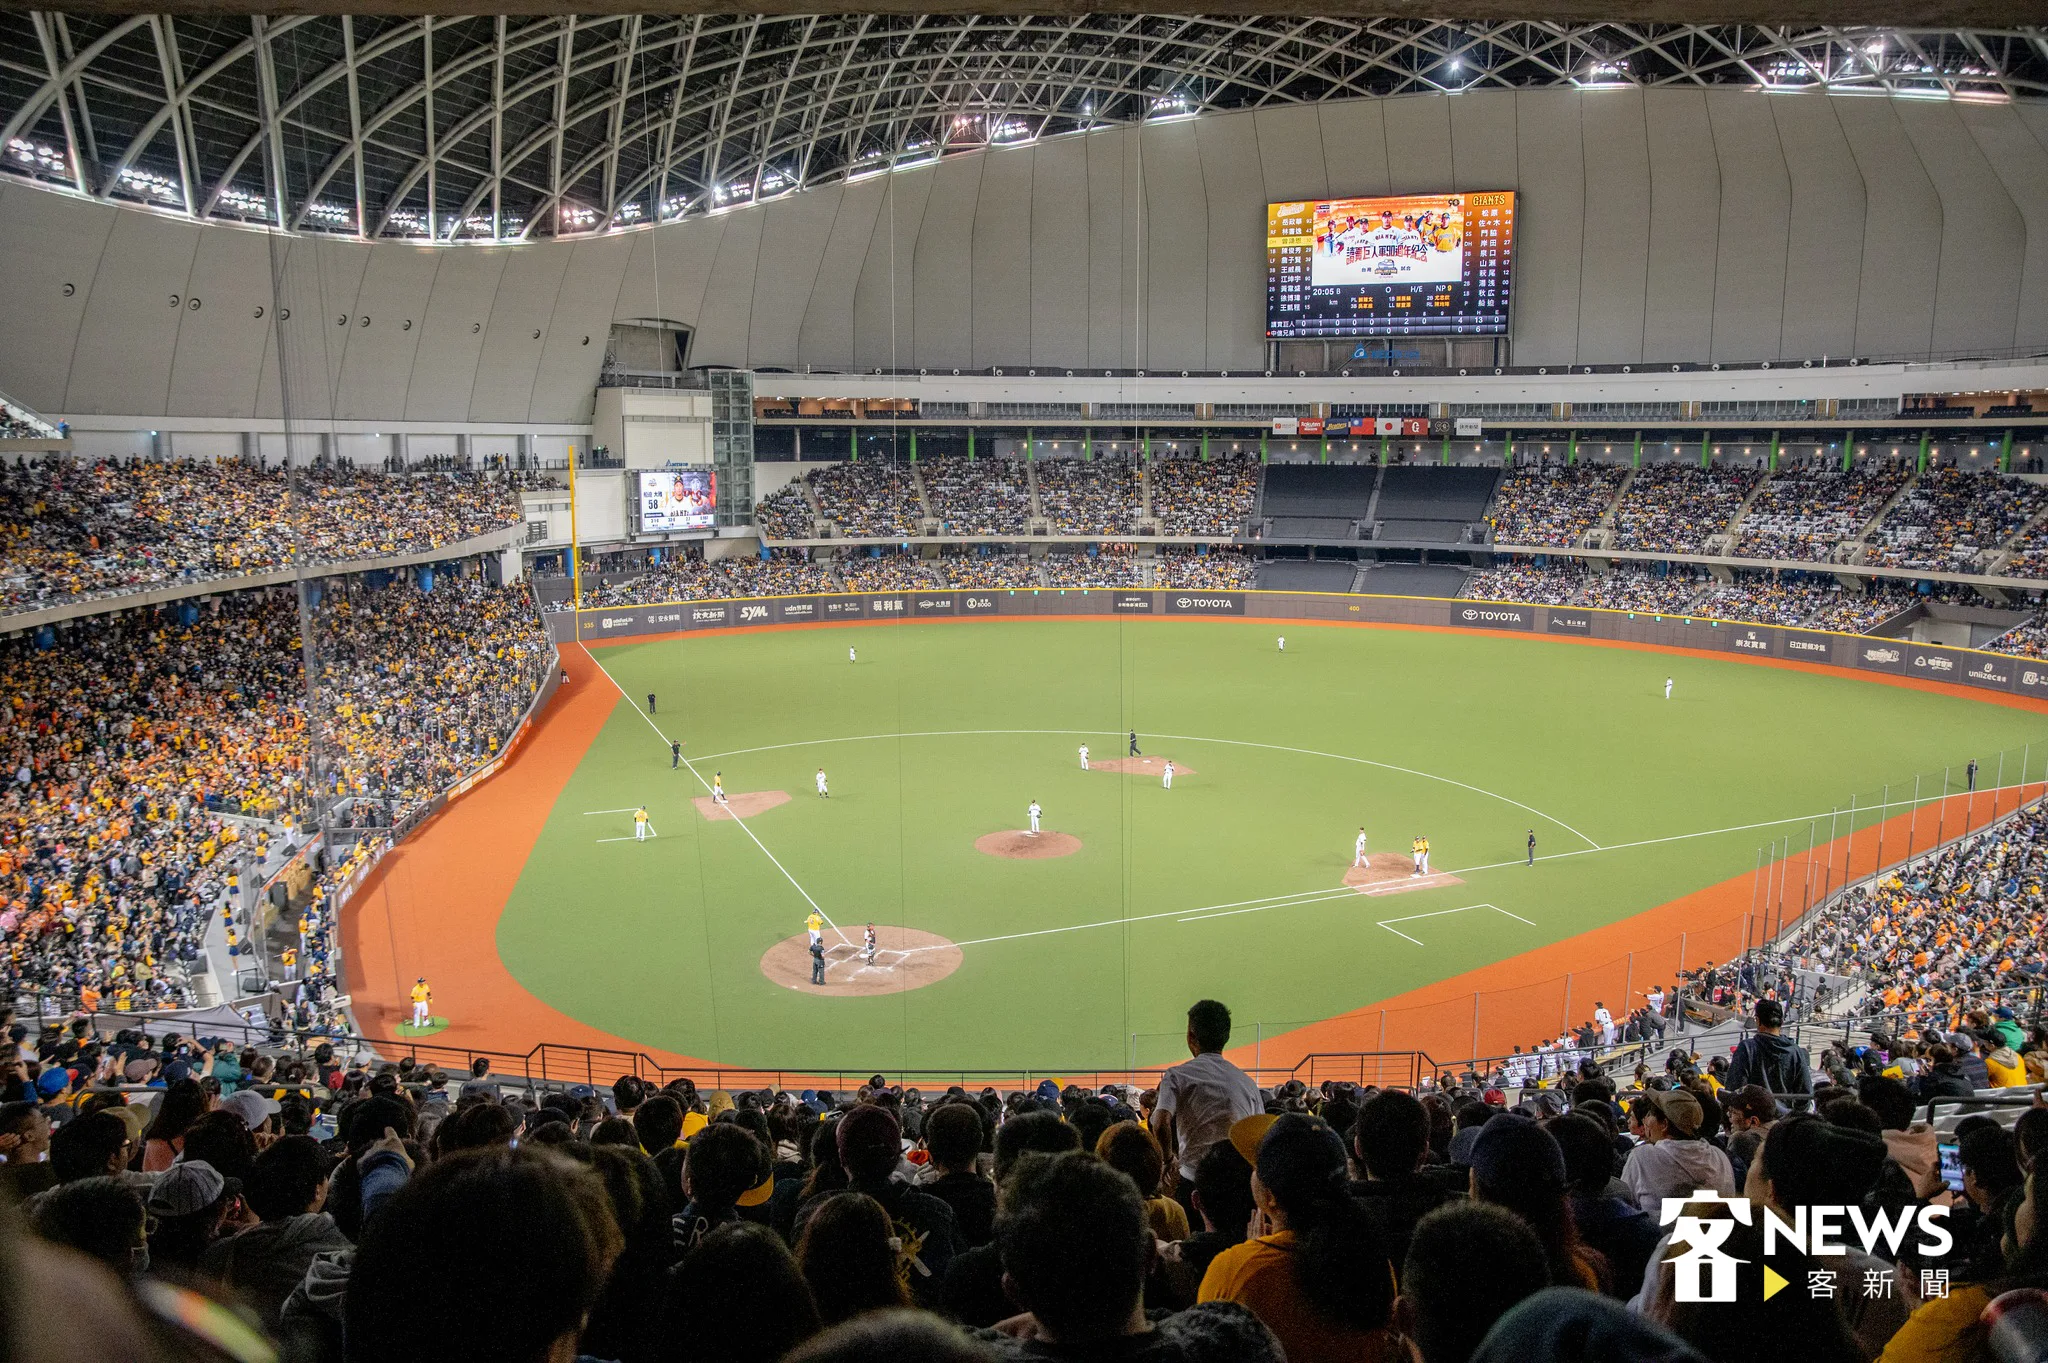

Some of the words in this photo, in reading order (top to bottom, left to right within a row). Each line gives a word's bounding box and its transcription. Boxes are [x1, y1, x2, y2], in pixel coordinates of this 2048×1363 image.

[1473, 194, 1504, 206] GIANTS
[648, 500, 658, 509] 58
[1193, 599, 1232, 608] TOYOTA
[740, 606, 768, 620] SYM
[1480, 611, 1521, 622] TOYOTA
